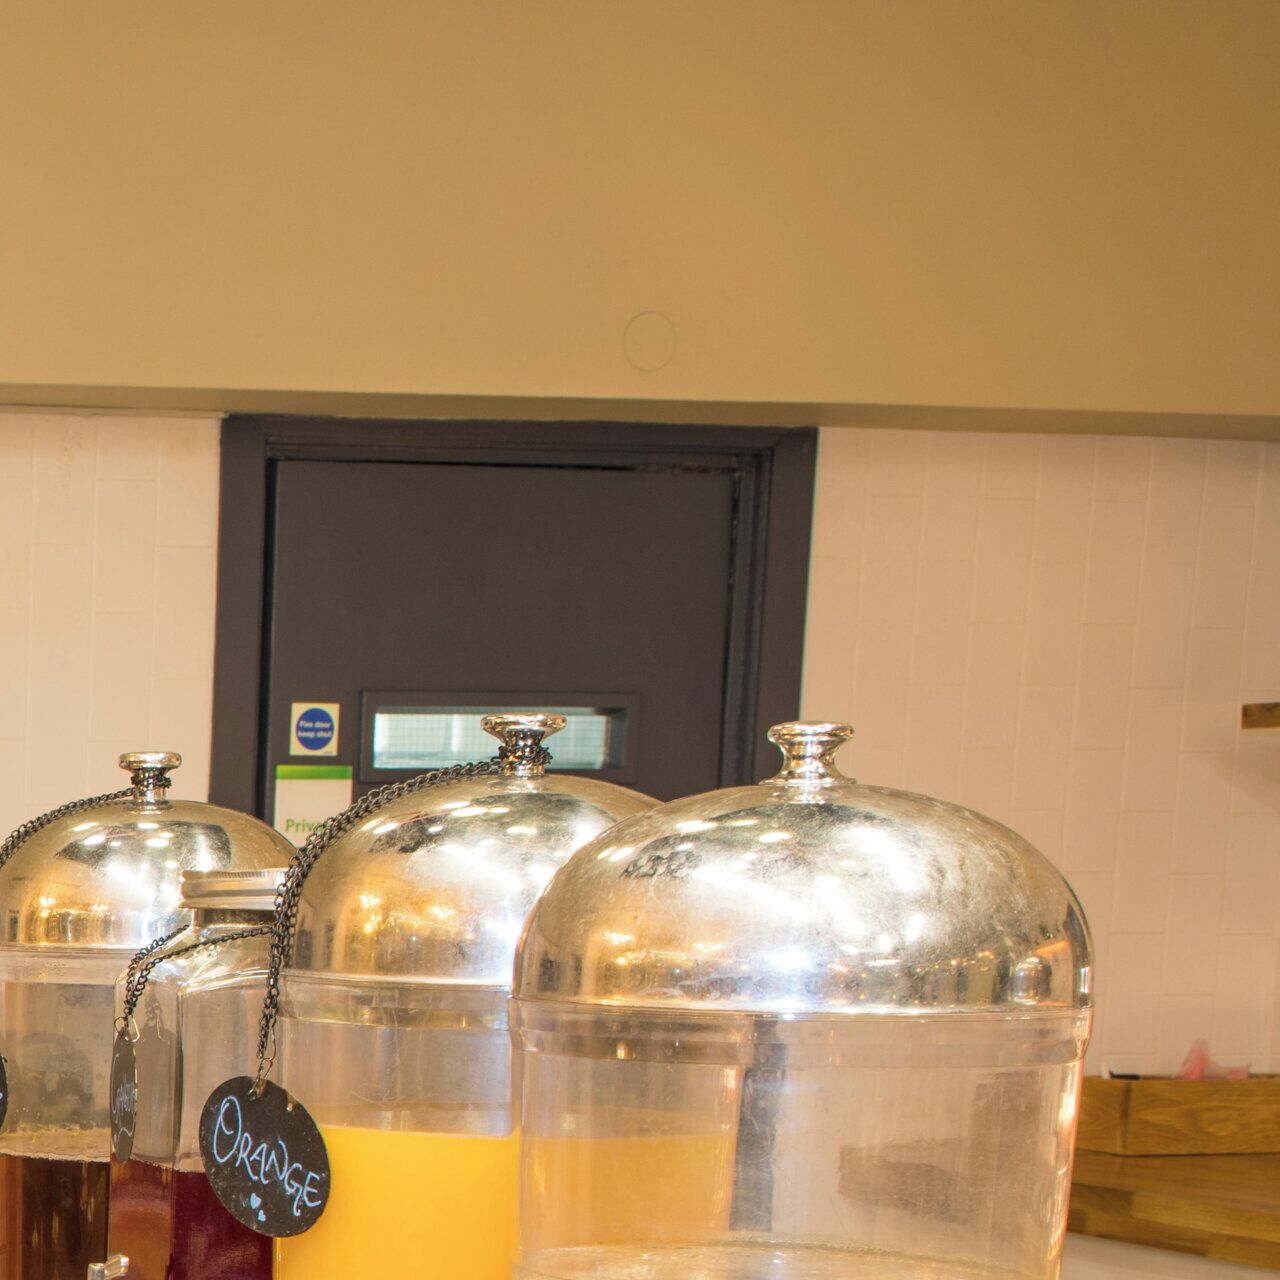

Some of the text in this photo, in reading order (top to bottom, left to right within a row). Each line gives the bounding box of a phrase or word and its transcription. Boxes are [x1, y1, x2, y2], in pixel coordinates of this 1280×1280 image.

[299, 720, 331, 728] Fire door
[298, 730, 332, 739] keep shut
[285, 817, 315, 832] Priv
